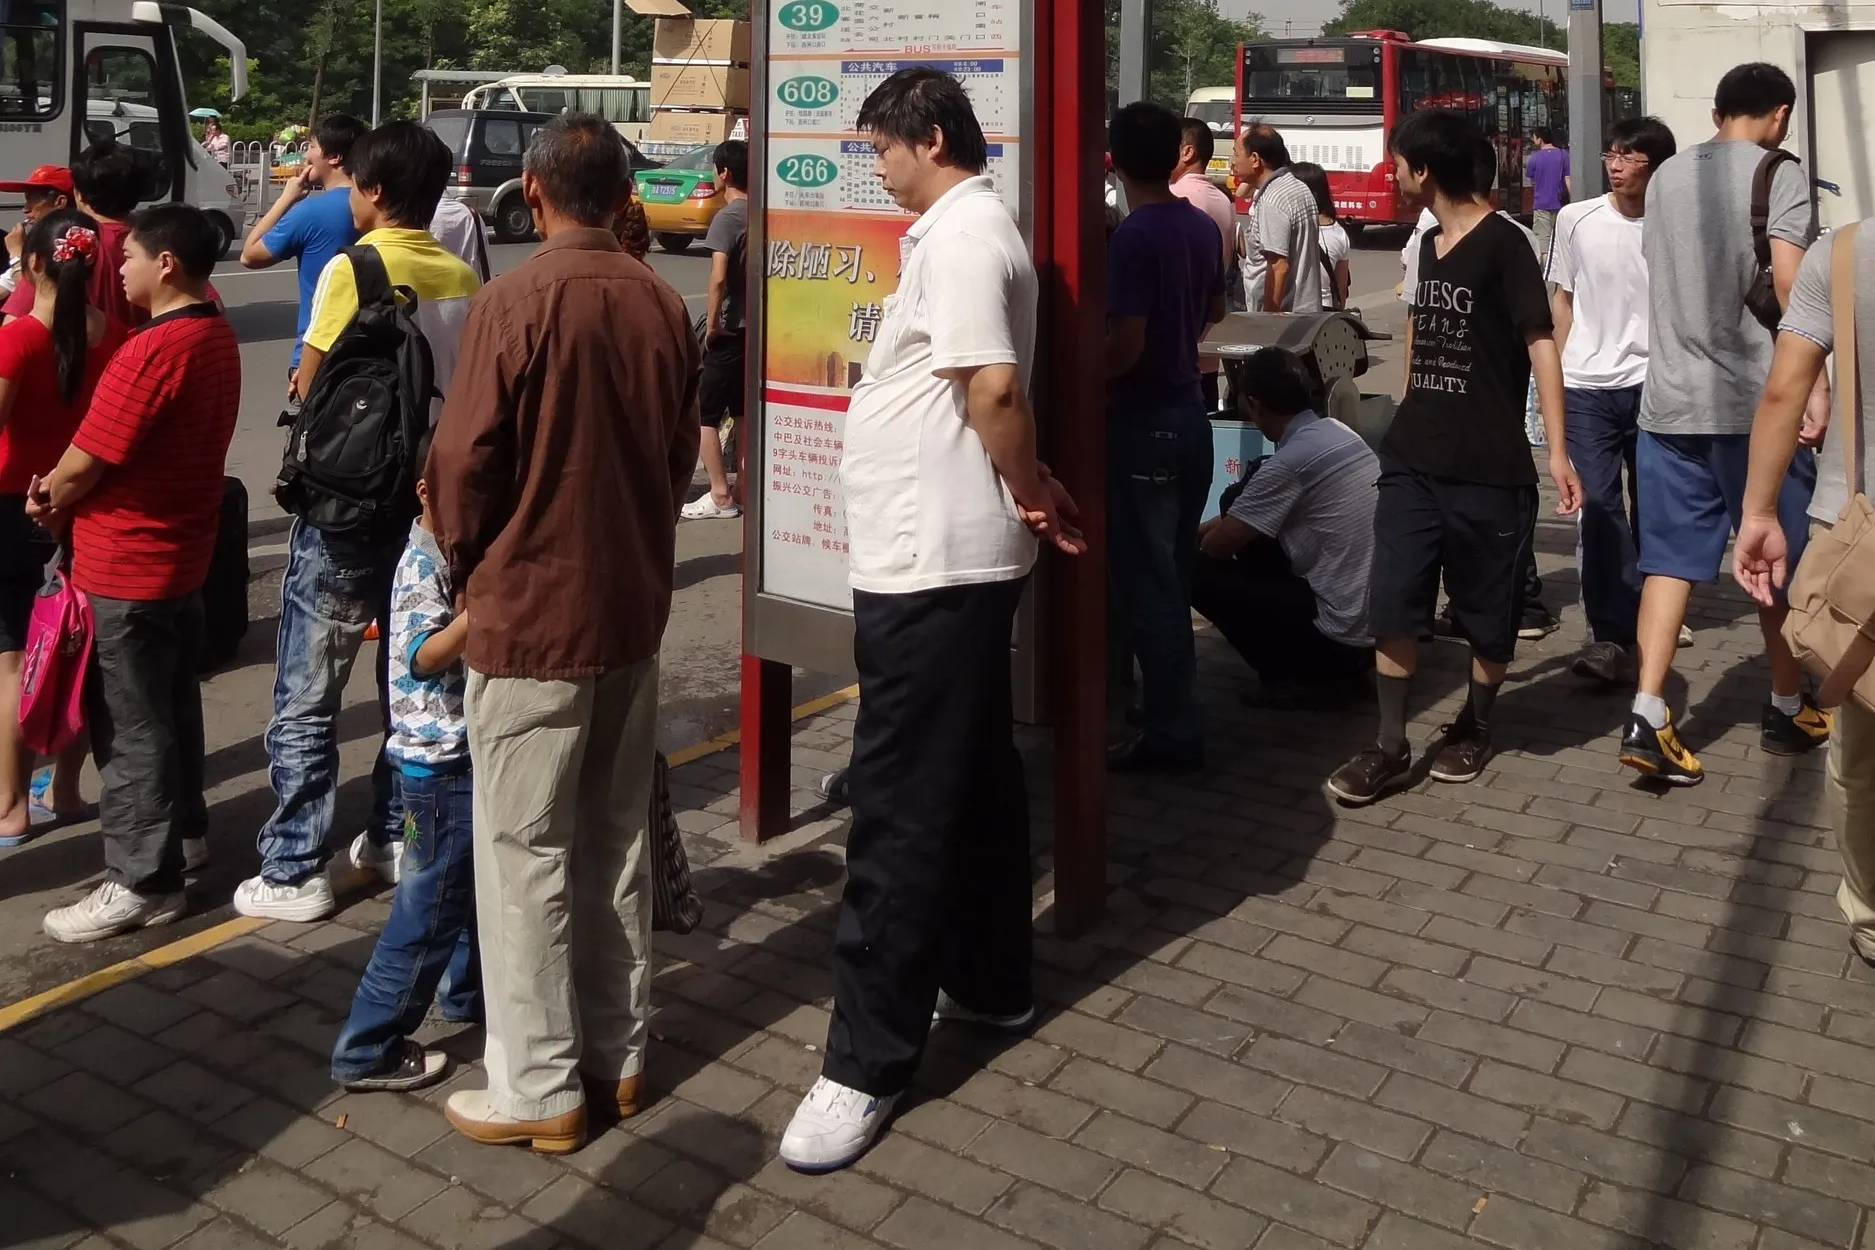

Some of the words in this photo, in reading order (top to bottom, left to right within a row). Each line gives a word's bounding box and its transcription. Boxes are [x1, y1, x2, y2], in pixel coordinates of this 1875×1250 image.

[791, 4, 823, 27] 39
[904, 44, 931, 54] BUS
[848, 62, 897, 73] 公共汽车
[784, 81, 831, 103] 608
[785, 158, 828, 182] 266
[848, 301, 882, 342] 请
[1413, 314, 1469, 338] EANS
[772, 448, 843, 467] 9字头车辆投诉
